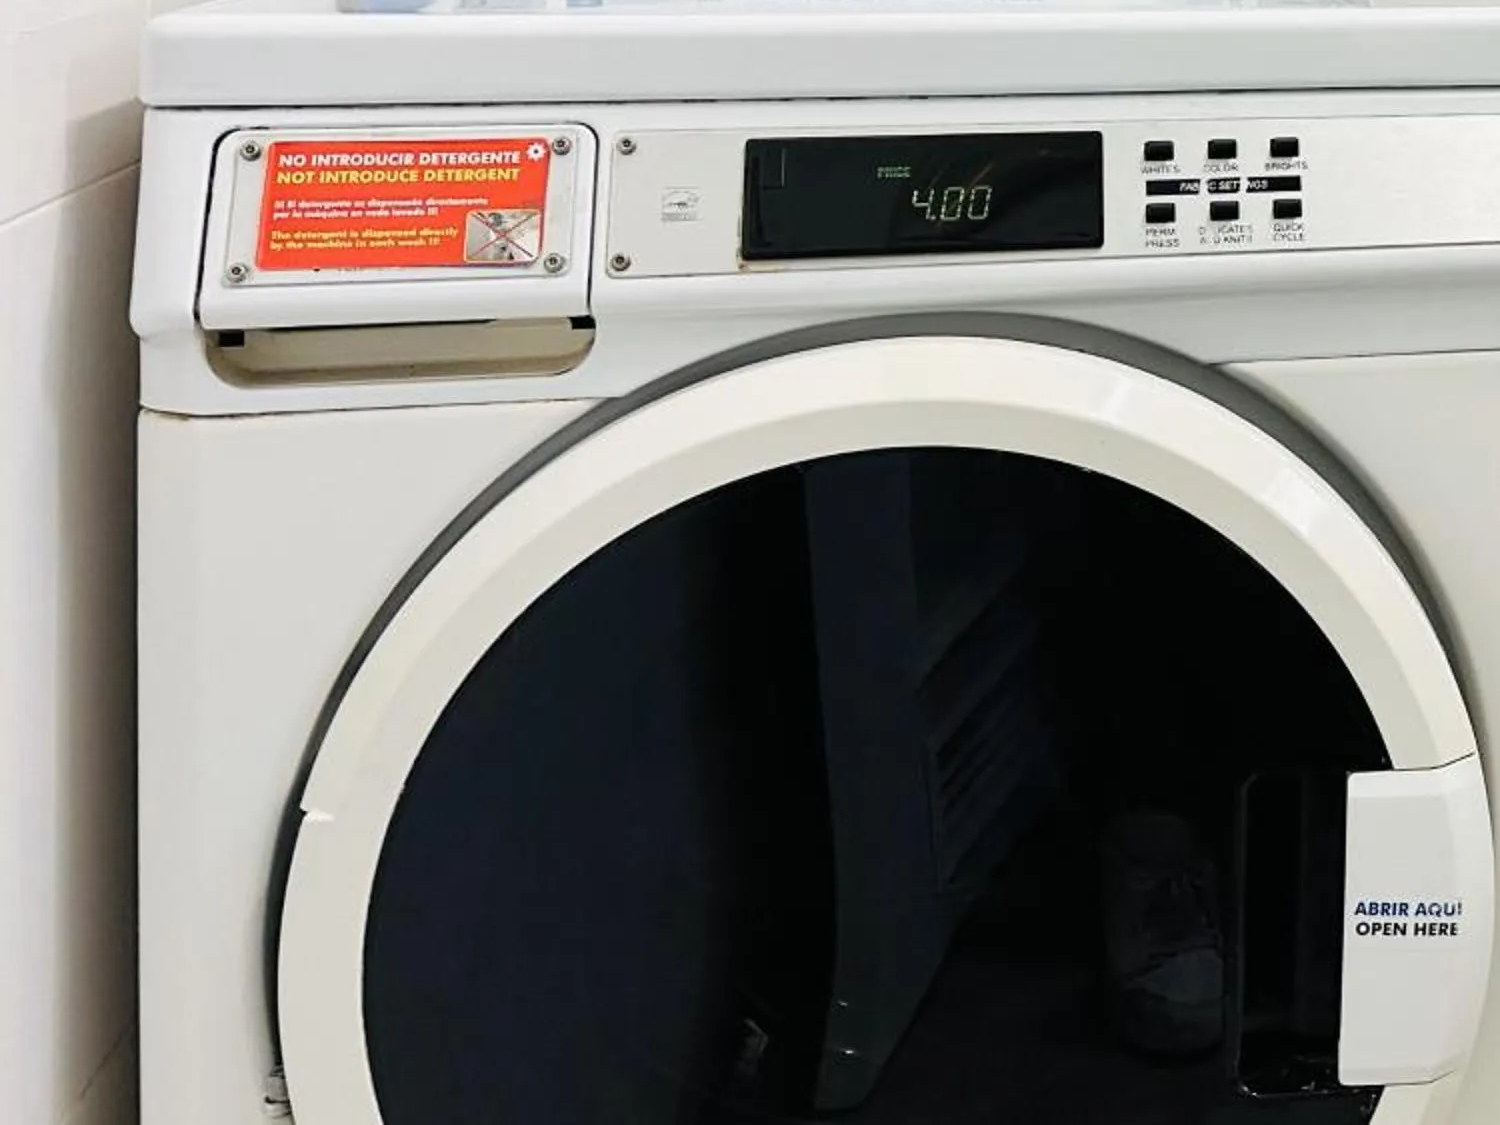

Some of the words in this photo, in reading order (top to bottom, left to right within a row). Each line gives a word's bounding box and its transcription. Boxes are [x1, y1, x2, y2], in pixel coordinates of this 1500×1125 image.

[279, 155, 306, 167] NO
[312, 153, 414, 167] INTRODUCIR
[418, 151, 520, 165] DETERGENTE
[276, 171, 315, 184] NOT
[319, 169, 418, 184] INTRODUCE
[423, 168, 520, 182] DETERGENT
[1179, 181, 1217, 193] FABC
[911, 185, 993, 221] 4.00
[293, 228, 347, 241] detergent
[1354, 901, 1409, 917] ABRIR
[1355, 921, 1407, 937] OPEN
[1413, 921, 1460, 937] HERE
